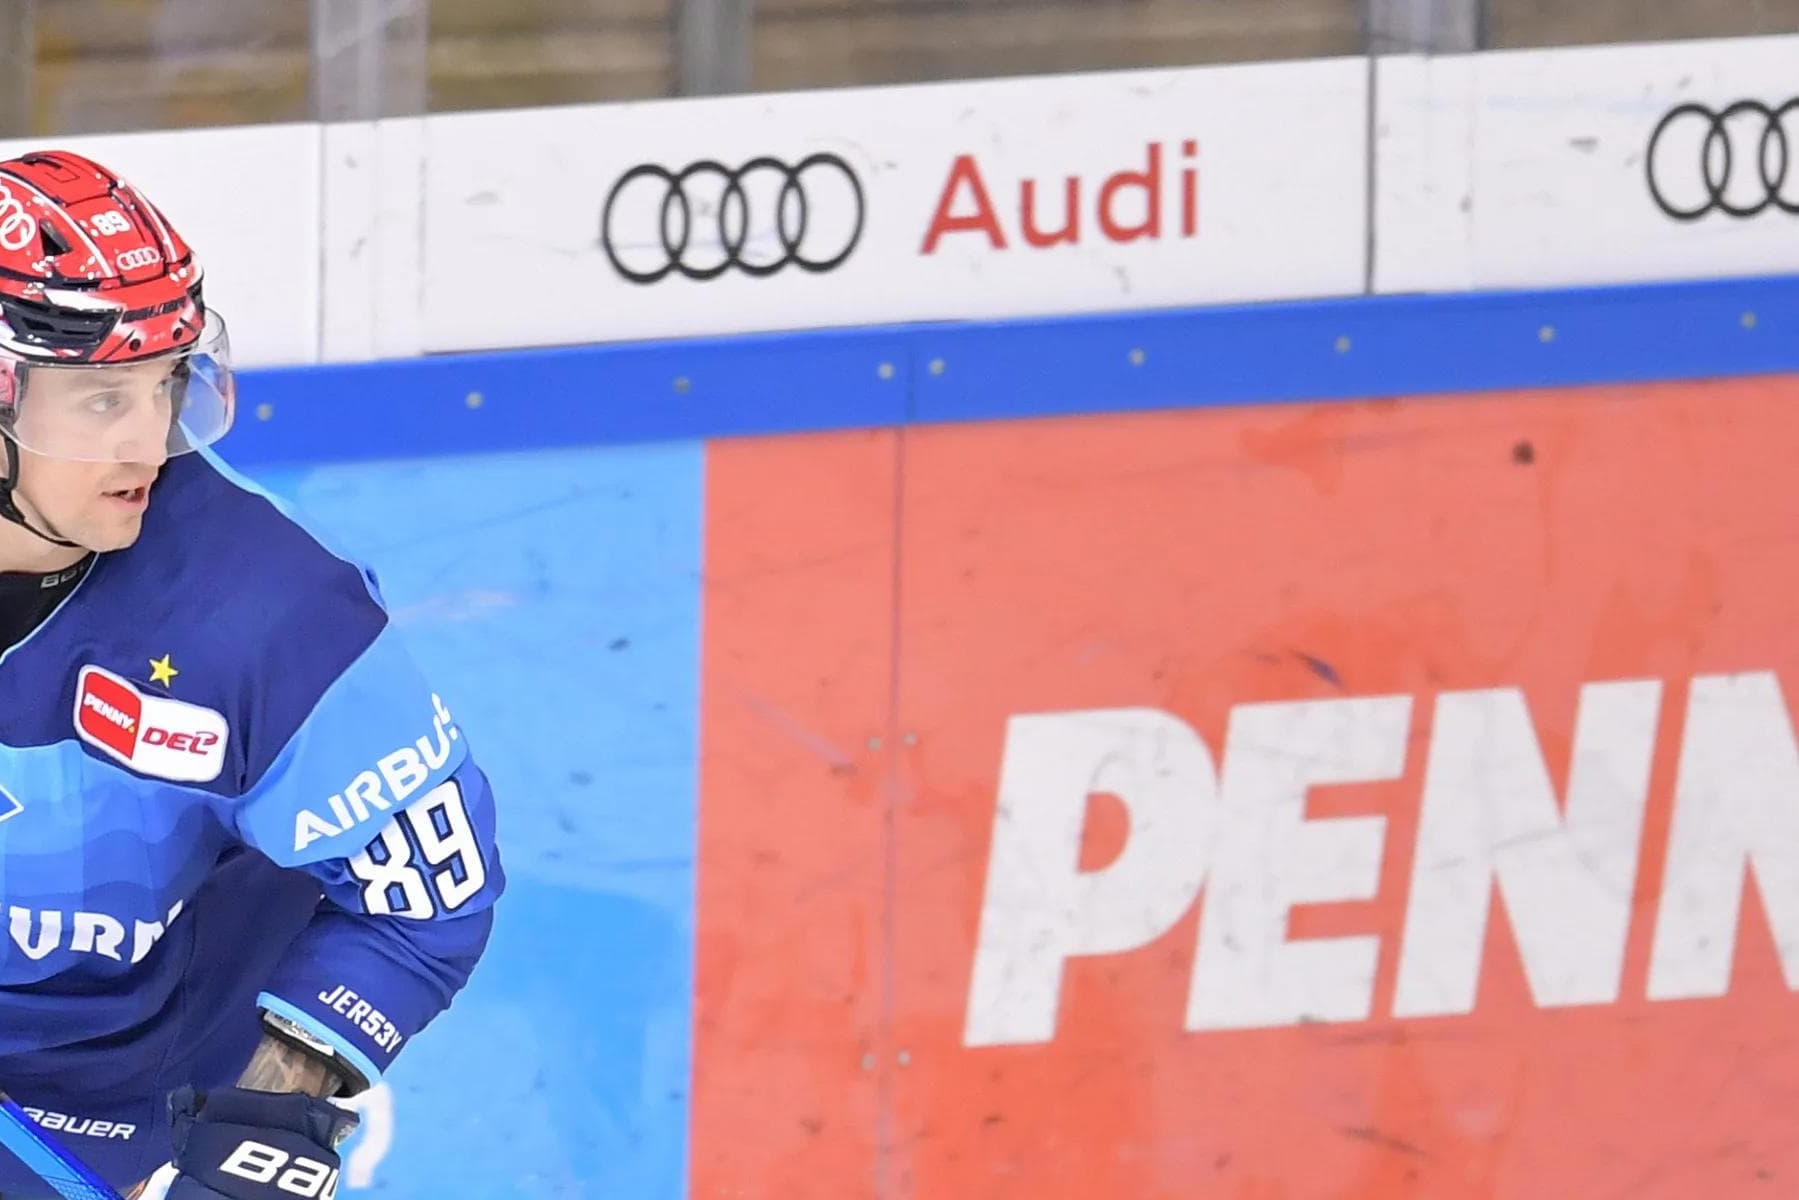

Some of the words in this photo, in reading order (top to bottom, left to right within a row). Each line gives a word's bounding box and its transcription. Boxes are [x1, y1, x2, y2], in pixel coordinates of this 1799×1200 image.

[91, 209, 131, 237] 89
[920, 140, 1198, 254] Audi
[347, 778, 487, 921] 89
